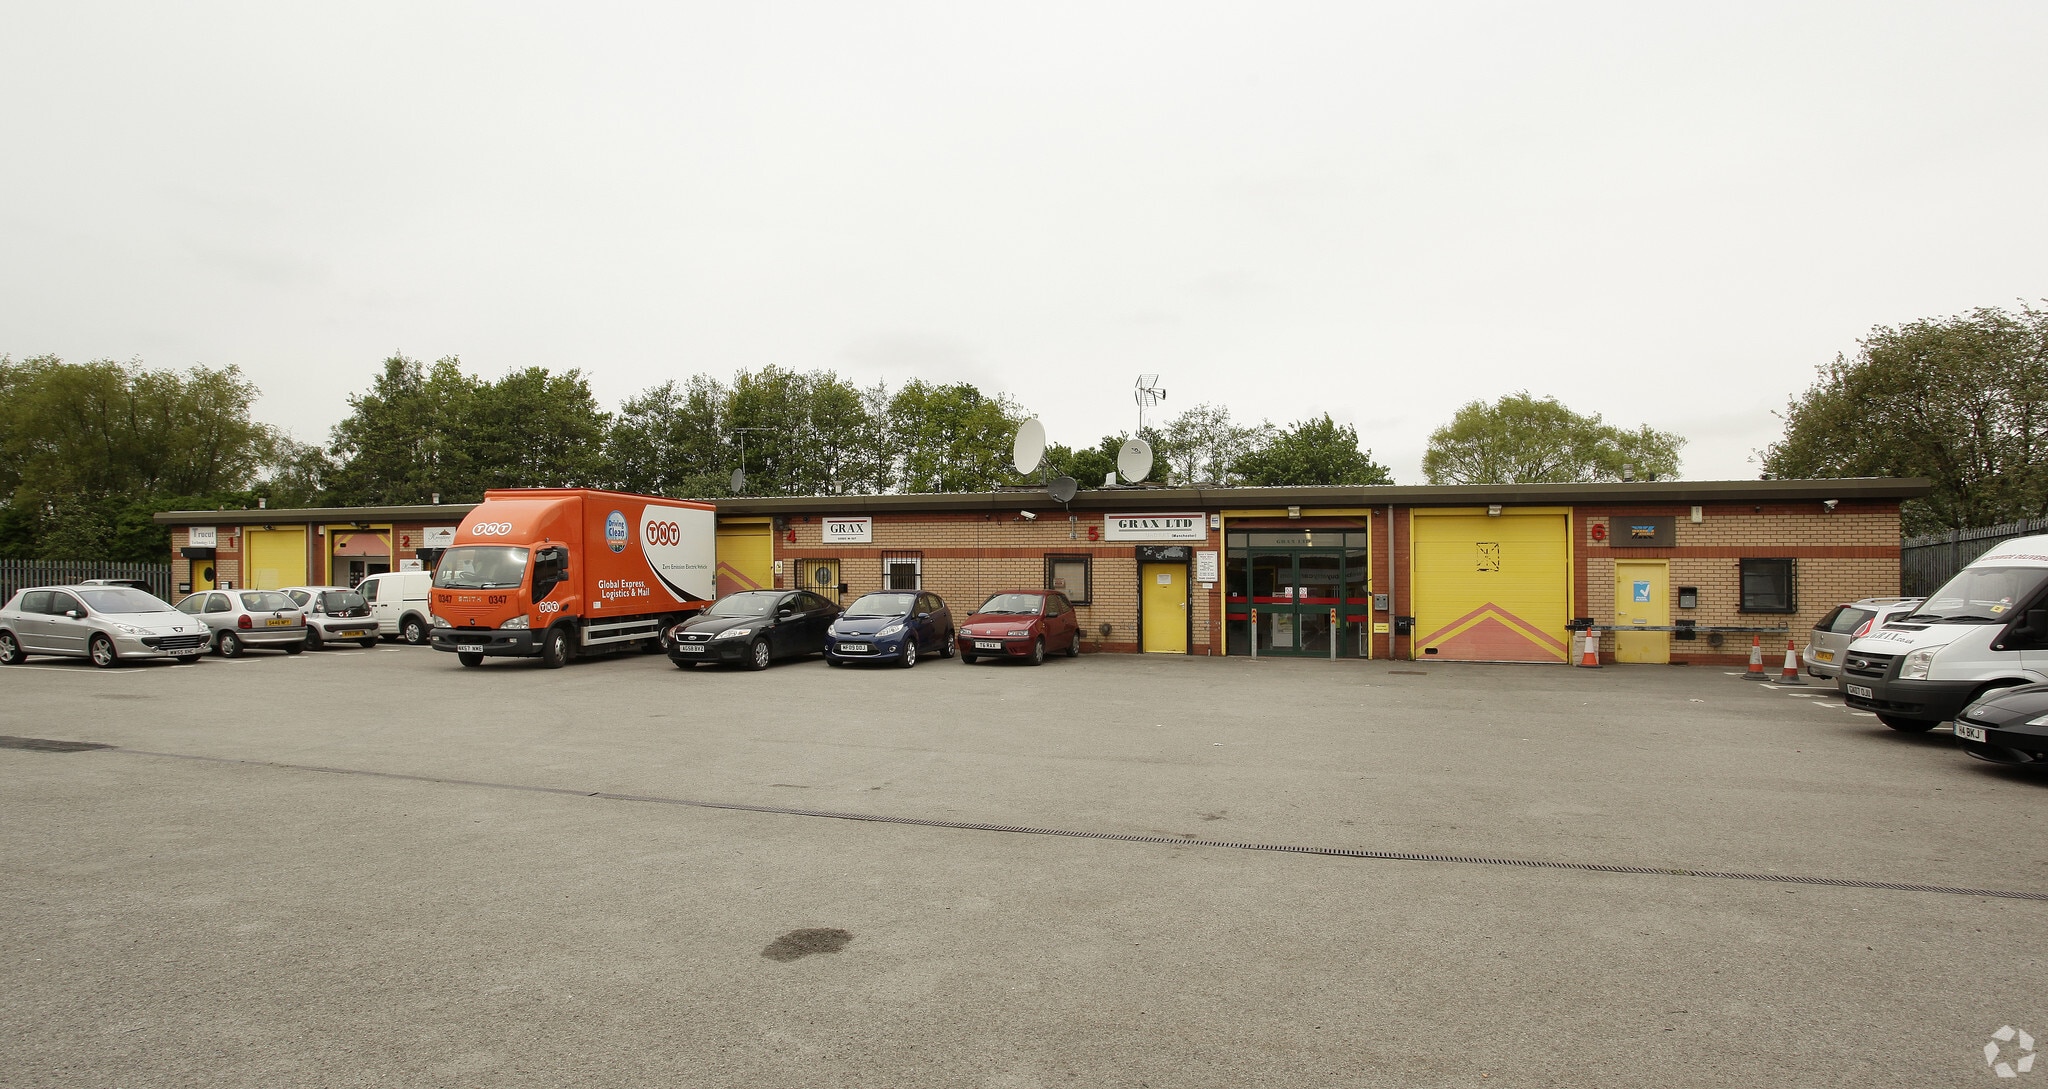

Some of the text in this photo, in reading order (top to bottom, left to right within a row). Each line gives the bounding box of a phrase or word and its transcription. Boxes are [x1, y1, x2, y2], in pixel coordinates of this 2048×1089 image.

[472, 522, 512, 536] TNT
[609, 520, 625, 529] Driving
[830, 523, 864, 533] GRAX
[1118, 518, 1193, 528] GRAX LTD
[192, 528, 214, 538] Trucut
[609, 528, 625, 537] Clean
[646, 520, 680, 546] TNT
[787, 529, 797, 543] 4
[1088, 526, 1099, 541] 5
[1592, 523, 1605, 541] 6
[228, 536, 234, 549] 1
[402, 535, 410, 547] 2
[598, 579, 646, 591] Global Express,
[438, 594, 453, 604] 0347
[488, 595, 508, 605] 0347
[602, 587, 650, 602] Logistics & Mail
[539, 601, 560, 614] TNT
[1958, 725, 1980, 739] H4 BKJ
